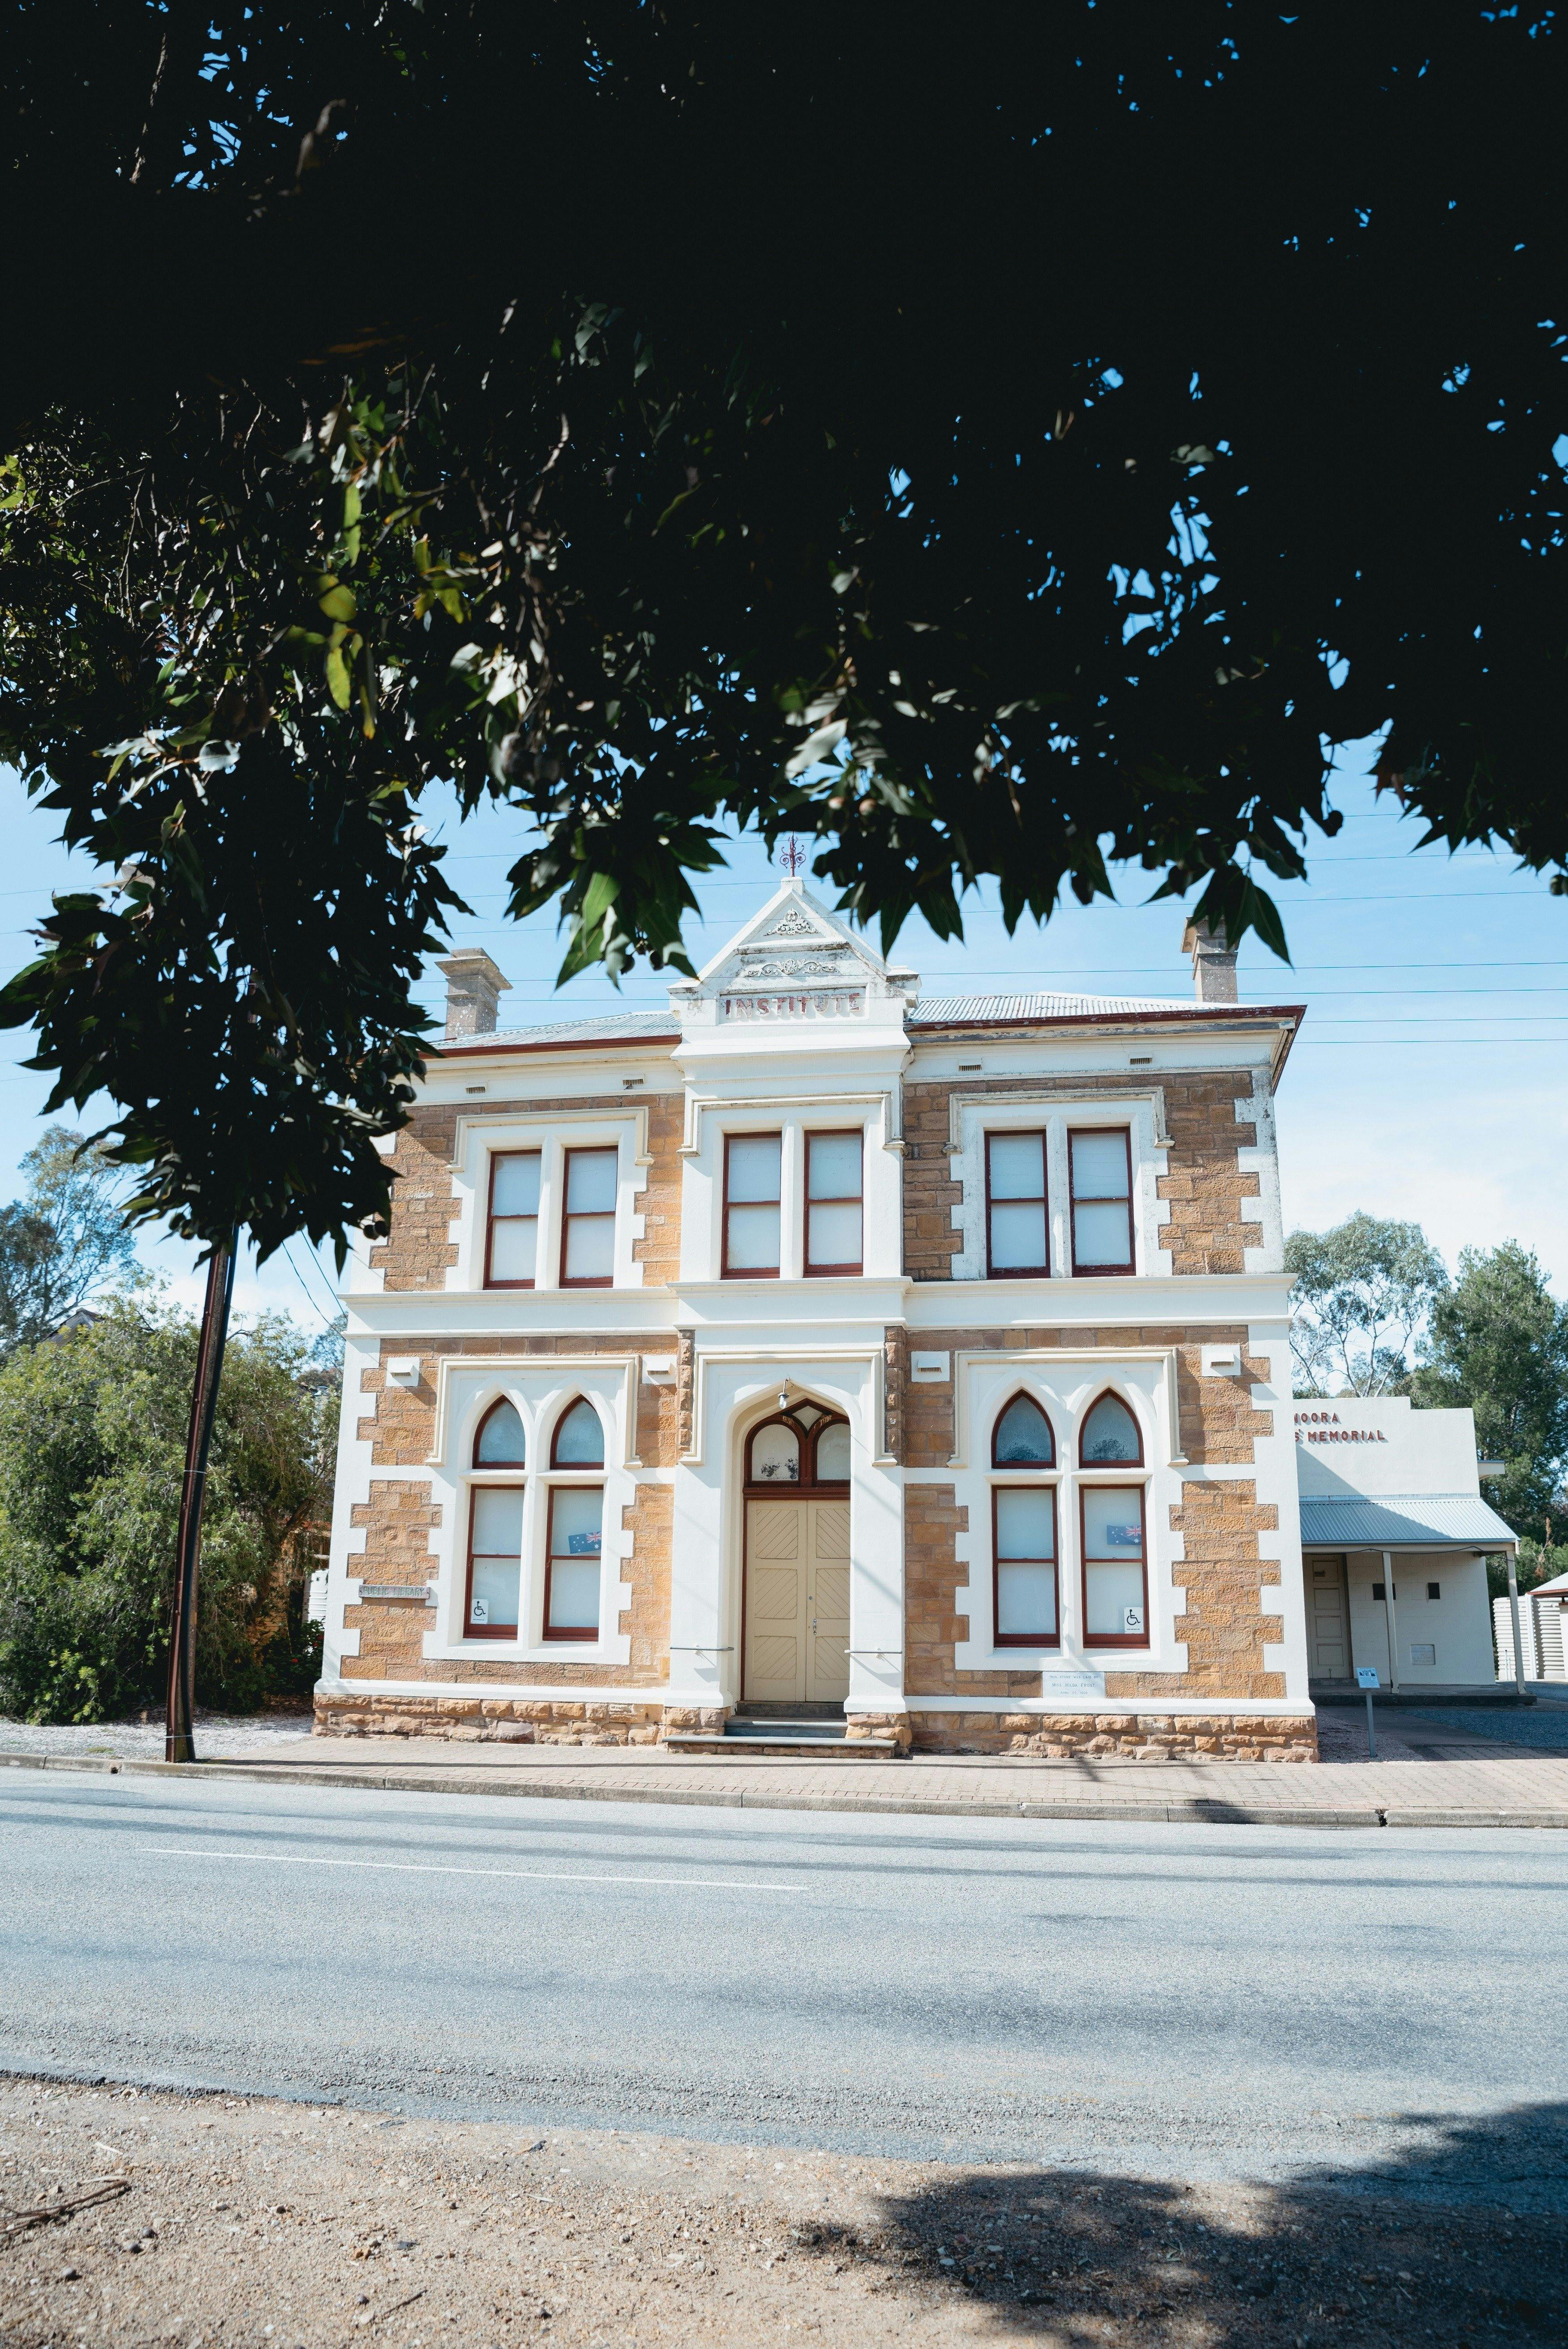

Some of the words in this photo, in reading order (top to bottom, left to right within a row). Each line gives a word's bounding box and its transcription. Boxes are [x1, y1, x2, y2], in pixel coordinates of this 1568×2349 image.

[725, 993, 861, 1019] INSTITUTE
[1308, 1430, 1385, 1442] MEMORIAL
[363, 1586, 389, 1595] PUBLIC
[393, 1587, 424, 1596] LIBRARY
